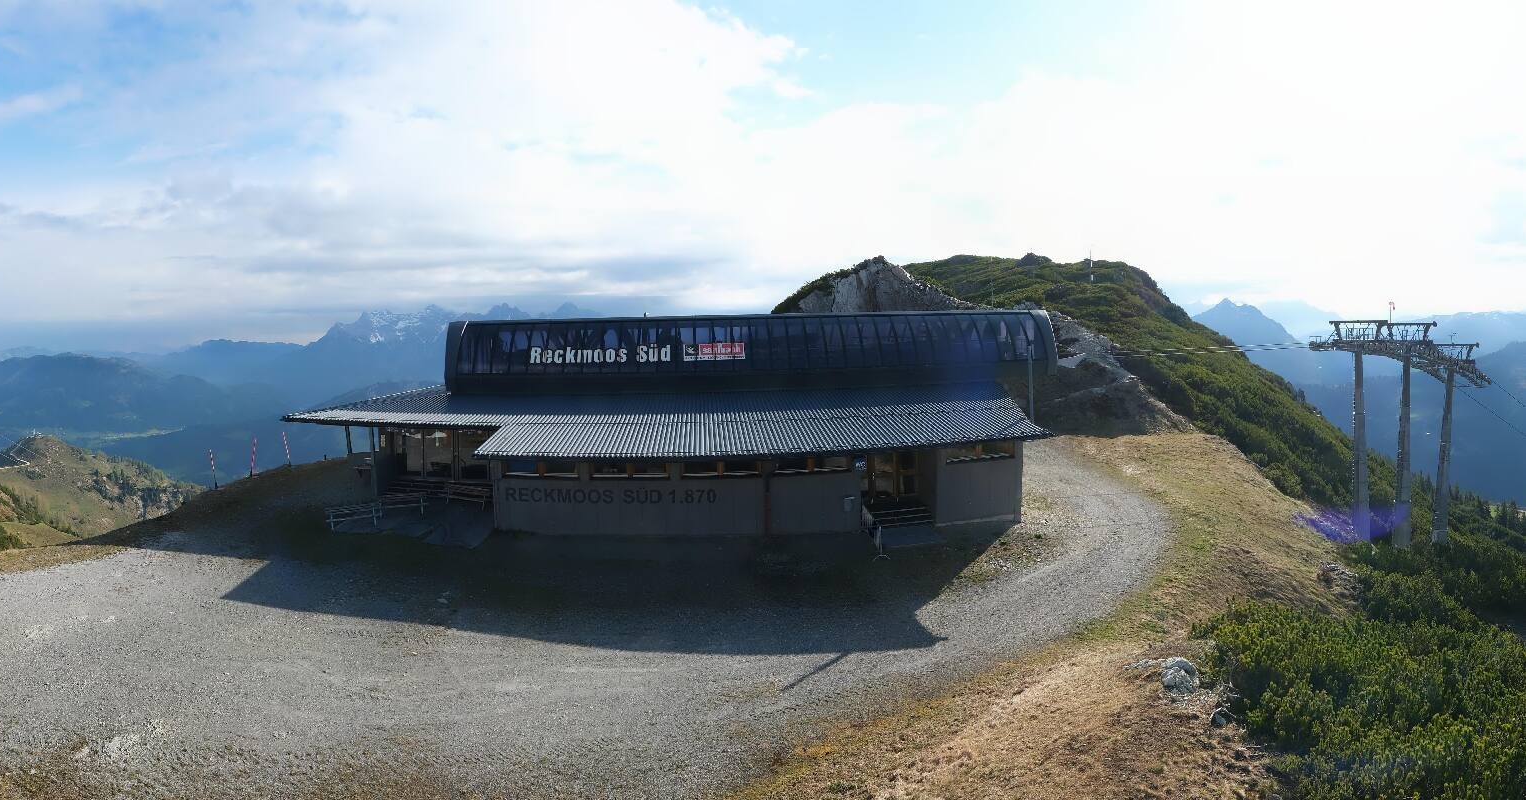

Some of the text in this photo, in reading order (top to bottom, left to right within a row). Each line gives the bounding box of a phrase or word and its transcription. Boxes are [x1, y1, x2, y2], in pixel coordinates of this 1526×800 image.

[530, 343, 671, 364] Reckmoos Süd
[504, 487, 717, 504] RECKMOOS SÜD 1.870
